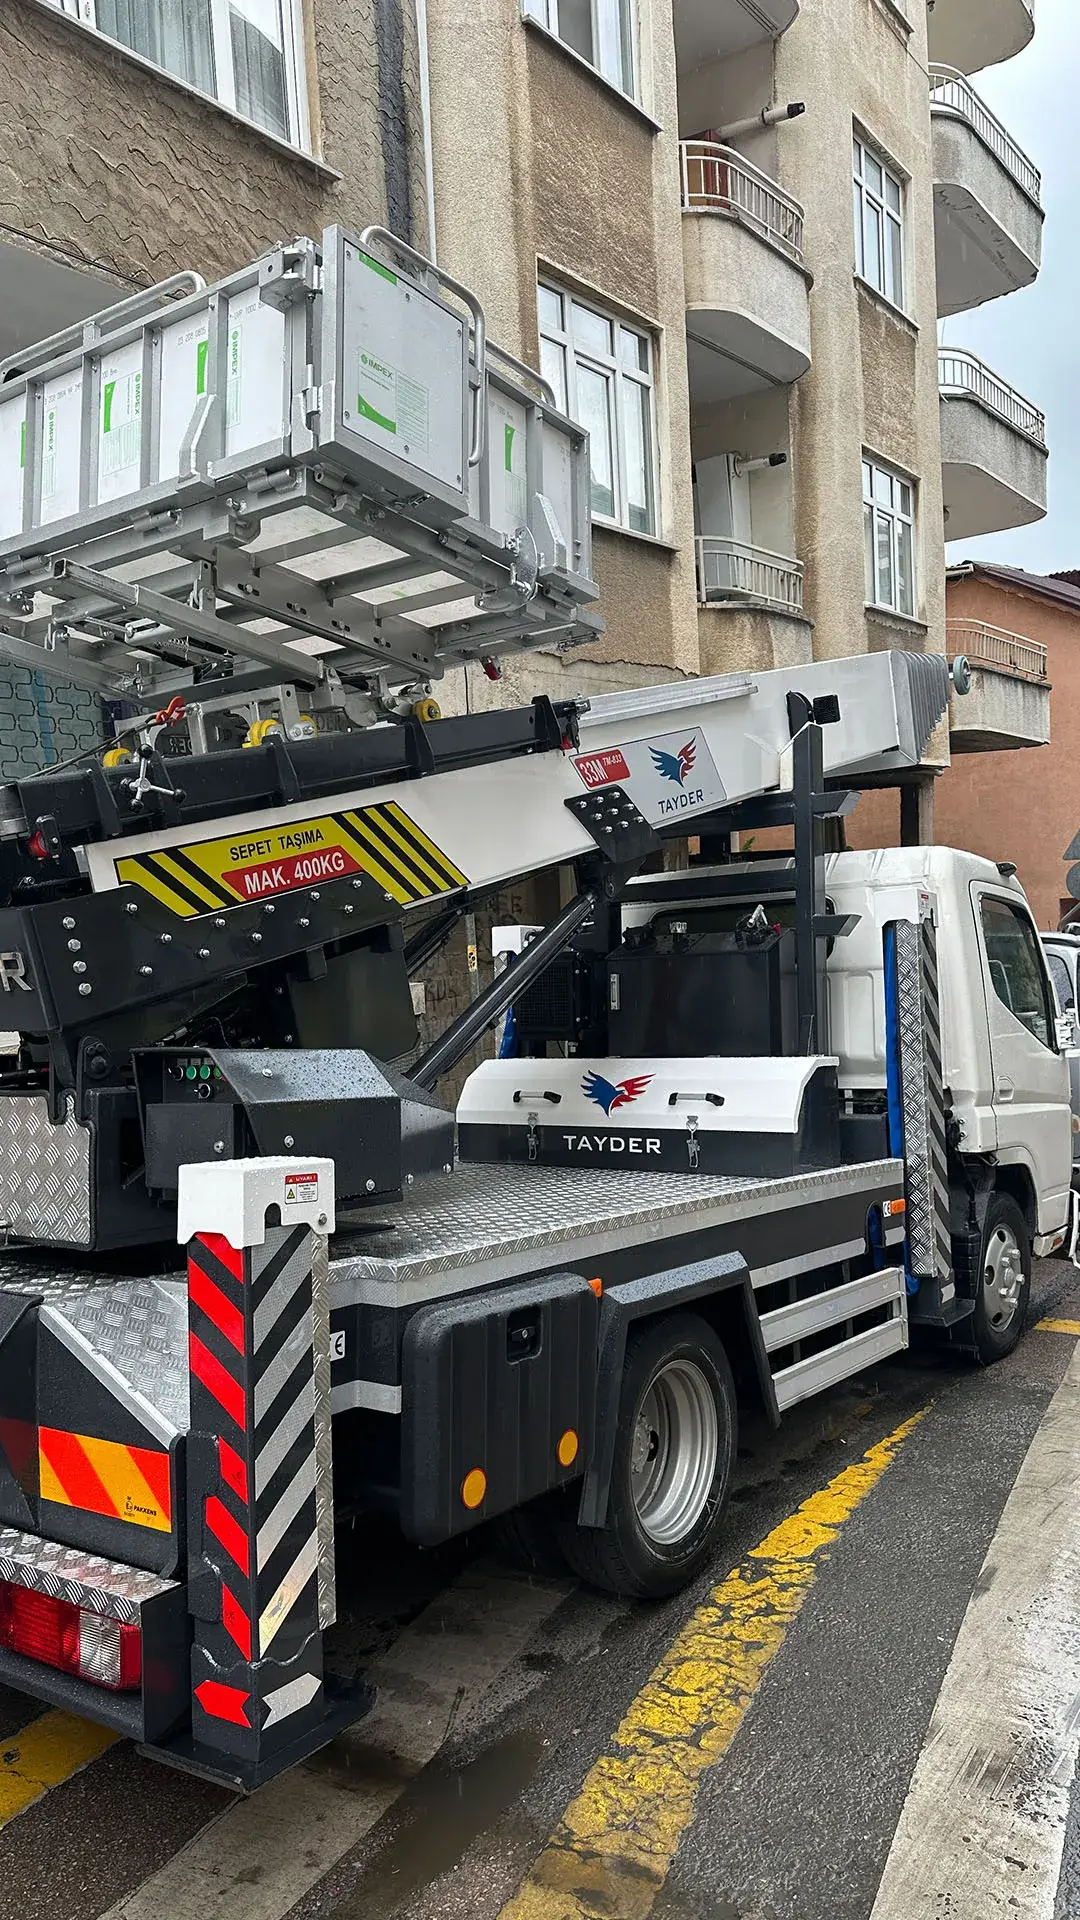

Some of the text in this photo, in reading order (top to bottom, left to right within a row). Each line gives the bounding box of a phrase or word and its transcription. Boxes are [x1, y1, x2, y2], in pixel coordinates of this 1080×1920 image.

[231, 341, 239, 376] IMPEX
[368, 358, 394, 380] IMPEX
[579, 759, 609, 784] 33M
[658, 789, 704, 814] TAYDER
[229, 828, 325, 861] SEPET TAŞIMA
[244, 851, 345, 895] MAK. 400KG
[562, 1135, 662, 1154] TAYDER
